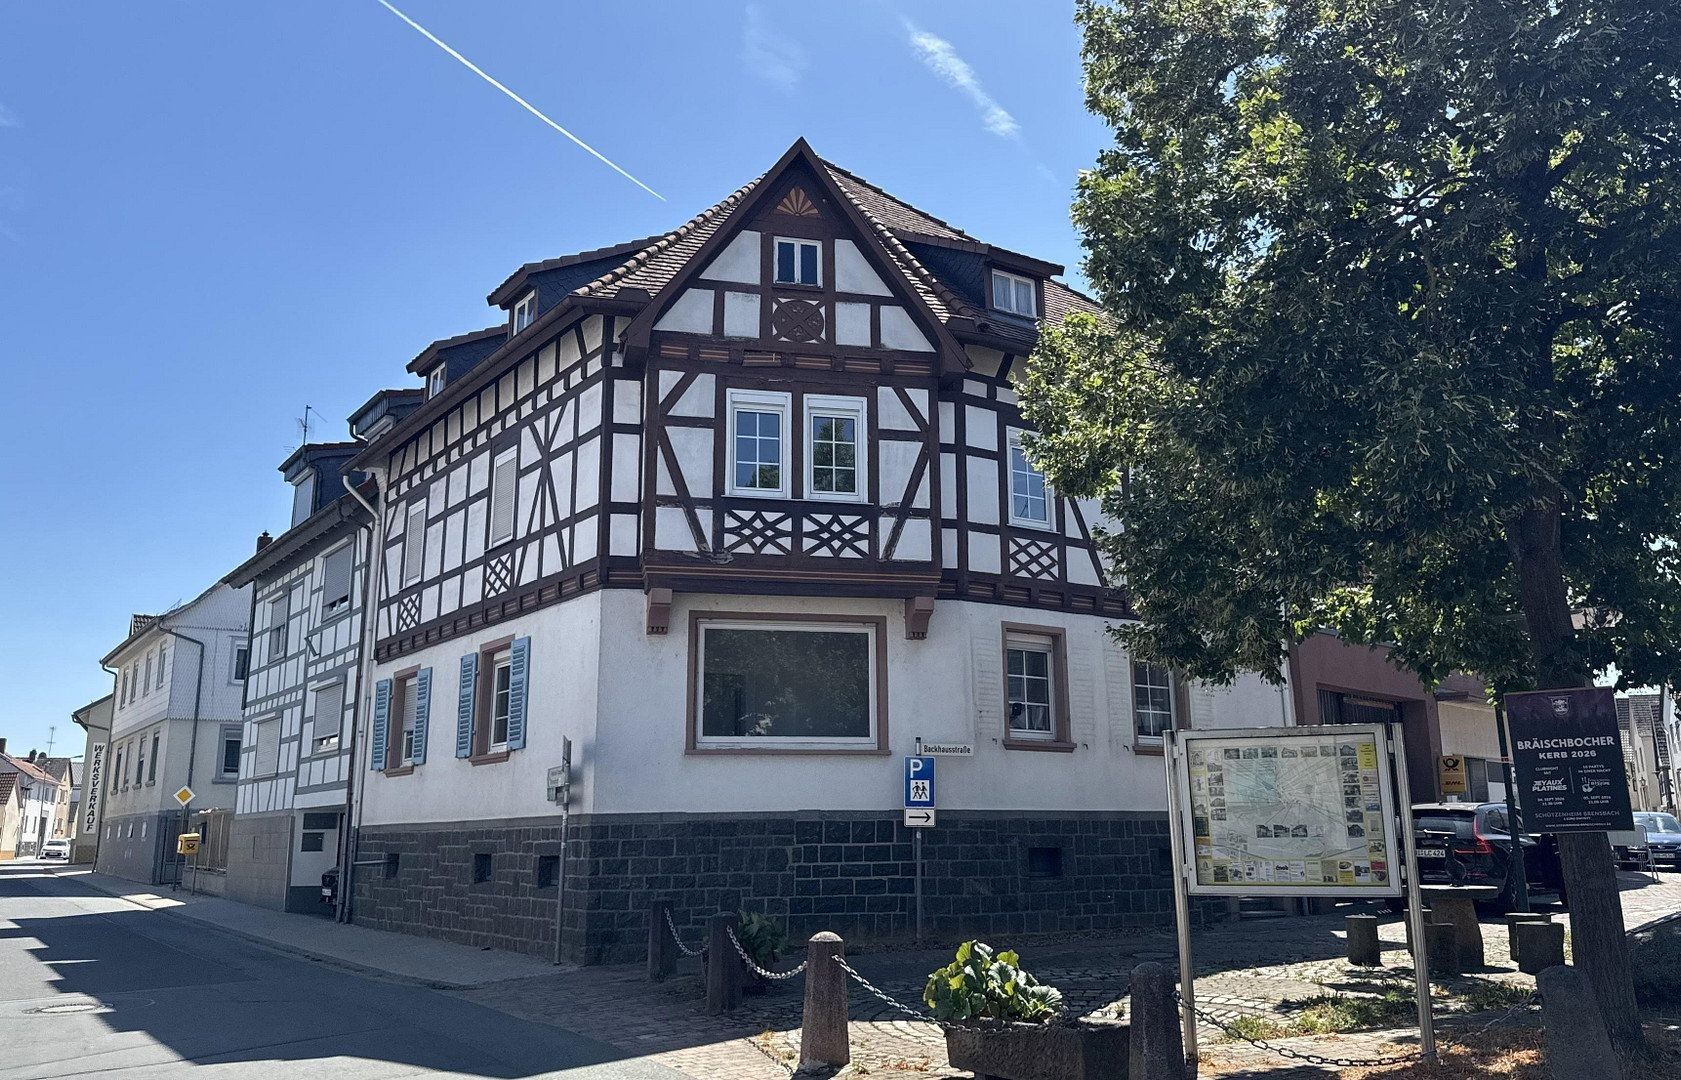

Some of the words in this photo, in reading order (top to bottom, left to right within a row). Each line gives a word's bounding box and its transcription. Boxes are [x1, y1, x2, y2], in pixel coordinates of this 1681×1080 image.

[923, 744, 971, 754] Backhausstraße
[1516, 736, 1615, 750] BRÄISCHBOCHER
[1538, 751, 1568, 760] KERB
[1571, 750, 1597, 758] 2026
[910, 759, 923, 779] P
[86, 744, 105, 832] WERKSVERKAUF
